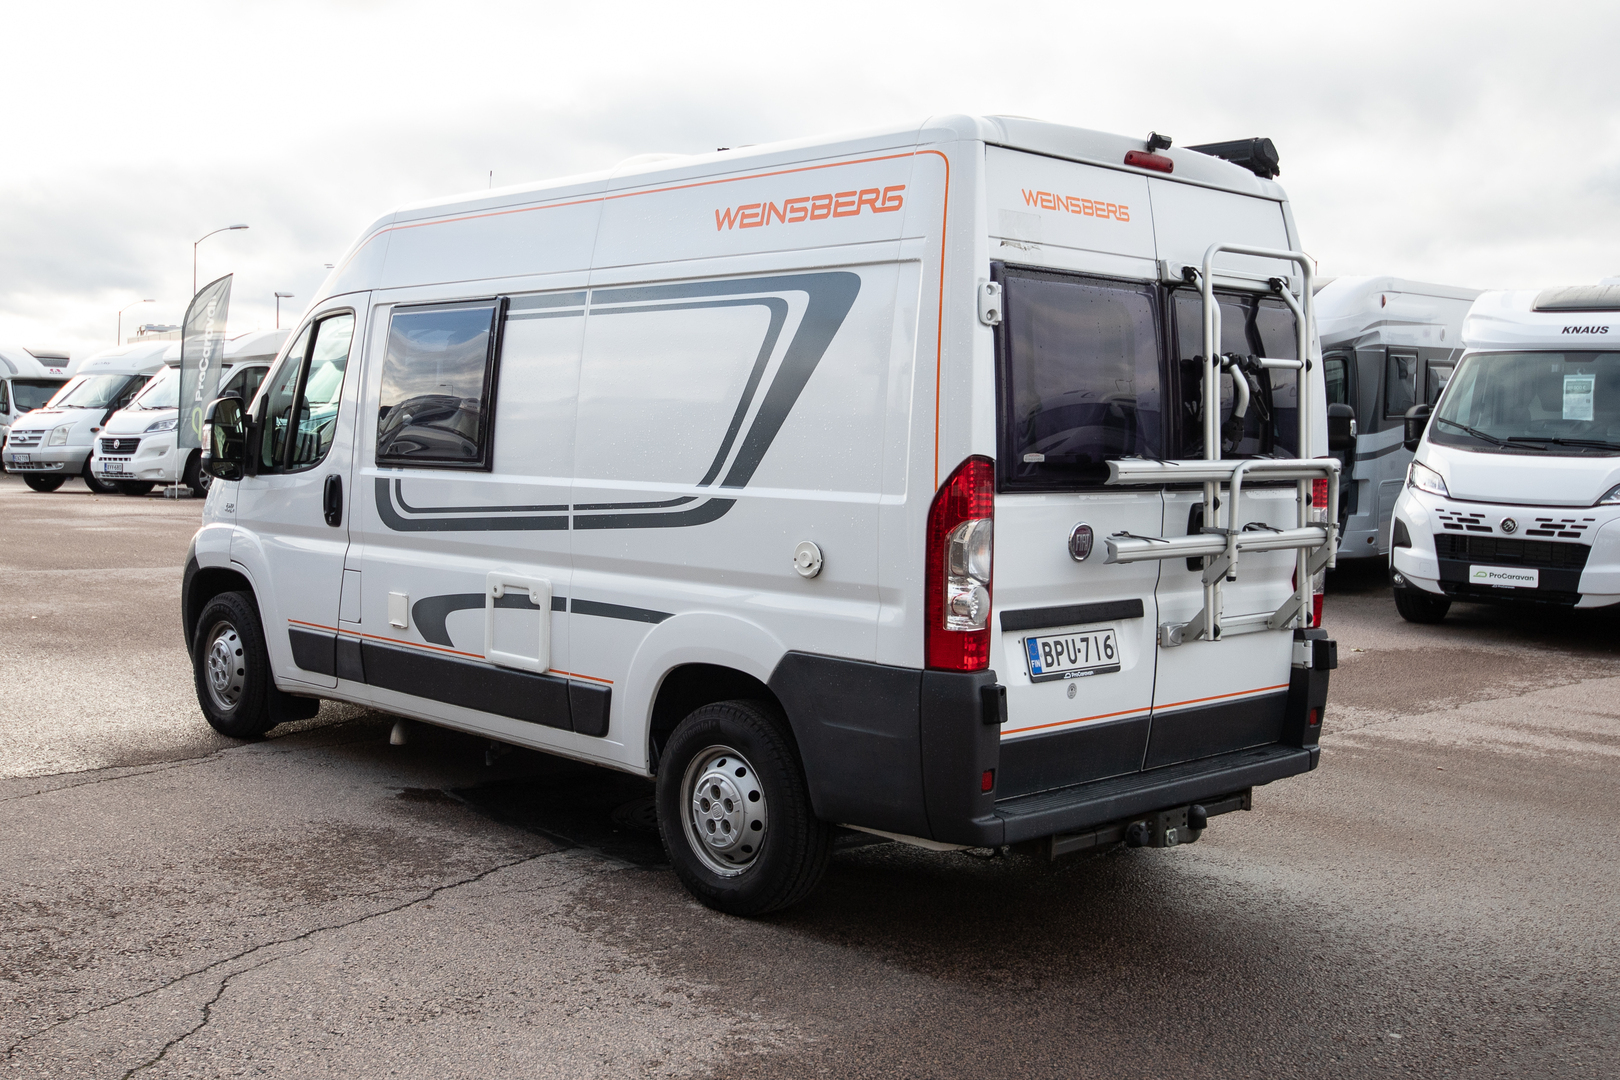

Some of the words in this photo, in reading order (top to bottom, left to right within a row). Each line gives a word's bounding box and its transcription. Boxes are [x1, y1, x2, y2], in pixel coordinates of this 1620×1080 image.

[715, 184, 906, 231] WEINSBERG
[1021, 188, 1130, 222] WEINSBERG
[1561, 326, 1610, 335] KNAUS
[1076, 533, 1090, 551] FIAT
[1489, 572, 1535, 581] ProCaravan
[1041, 634, 1115, 668] BPU-716
[1031, 659, 1041, 668] FIN
